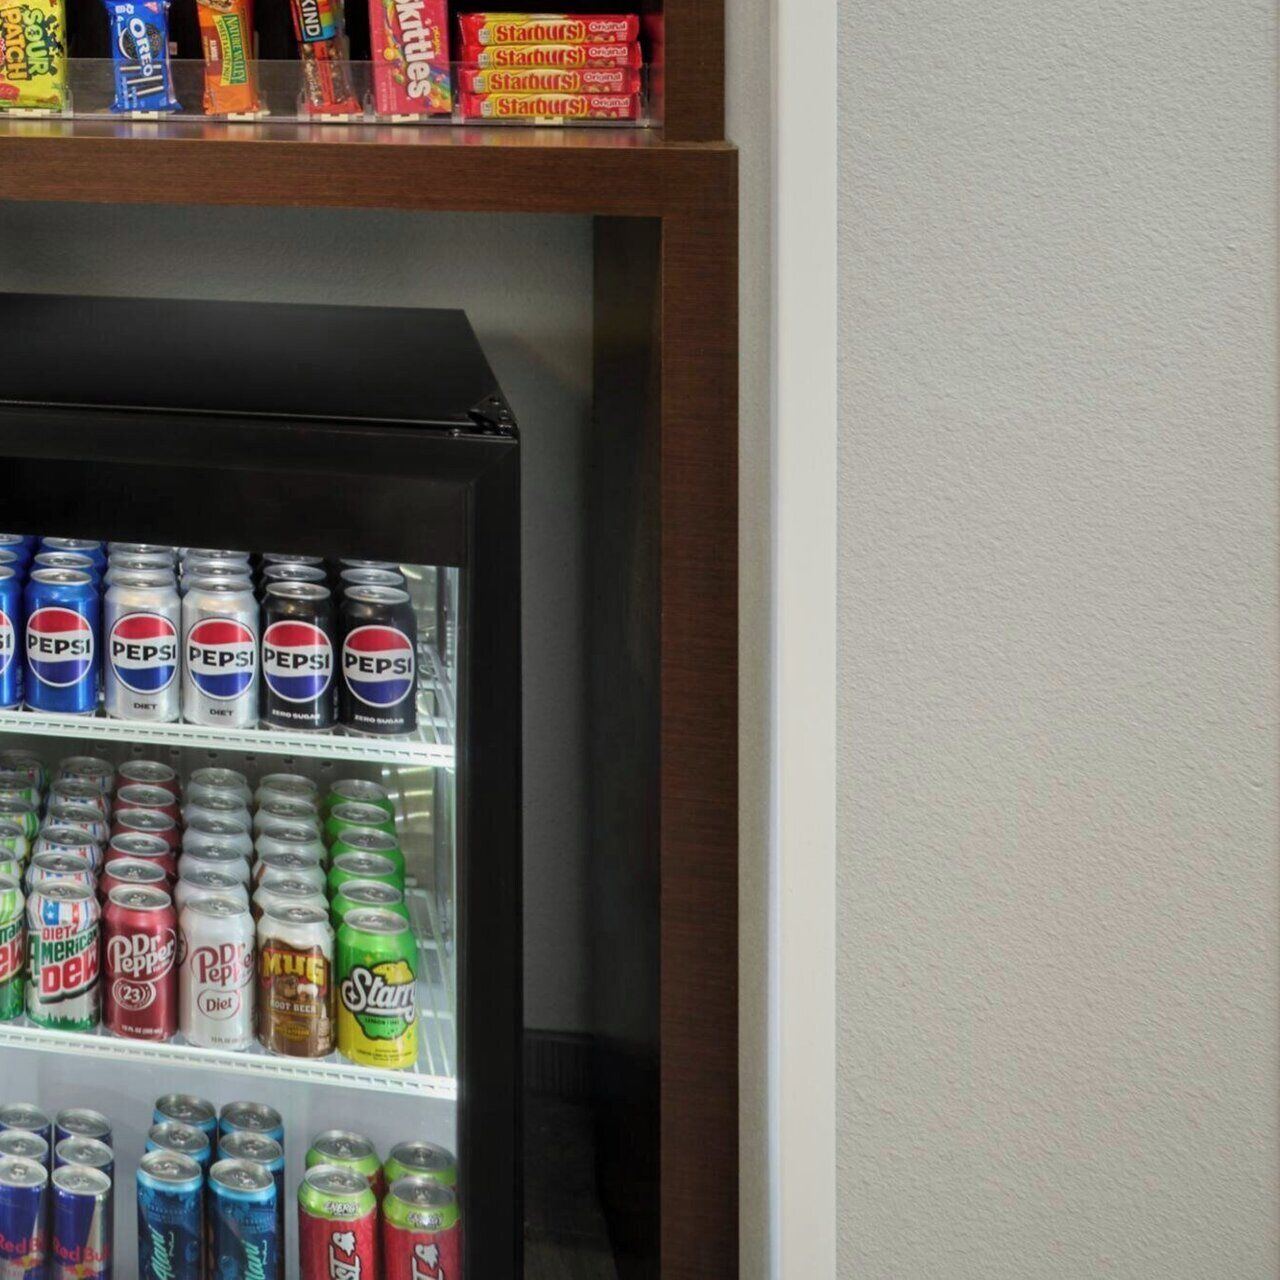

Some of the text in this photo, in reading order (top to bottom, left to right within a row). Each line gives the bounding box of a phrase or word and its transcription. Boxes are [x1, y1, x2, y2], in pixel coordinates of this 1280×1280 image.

[228, 15, 243, 50] NATURE
[496, 22, 627, 40] Starburst Original
[0, 7, 28, 80] PATCH
[23, 8, 50, 75] SOUR
[129, 18, 154, 76] OREO
[496, 47, 627, 66] Starburst Original
[491, 71, 622, 90] Starburst Original
[498, 96, 629, 115] Starburst Original
[28, 634, 90, 655] PEPSI
[113, 641, 176, 660] PEPSI
[190, 646, 253, 667] PEPSI
[264, 648, 330, 670] PEPSI
[345, 652, 411, 674] PEPSI
[272, 710, 320, 720] ZERO SUGAR
[355, 715, 404, 725] ZERO SUGAR
[132, 935, 159, 955] Dr
[107, 936, 175, 977] Pepper
[263, 952, 325, 986] MUG
[122, 986, 140, 1000] 23
[206, 997, 233, 1012] Diet
[293, 1003, 316, 1013] BEER
[52, 1239, 80, 1260] Red
